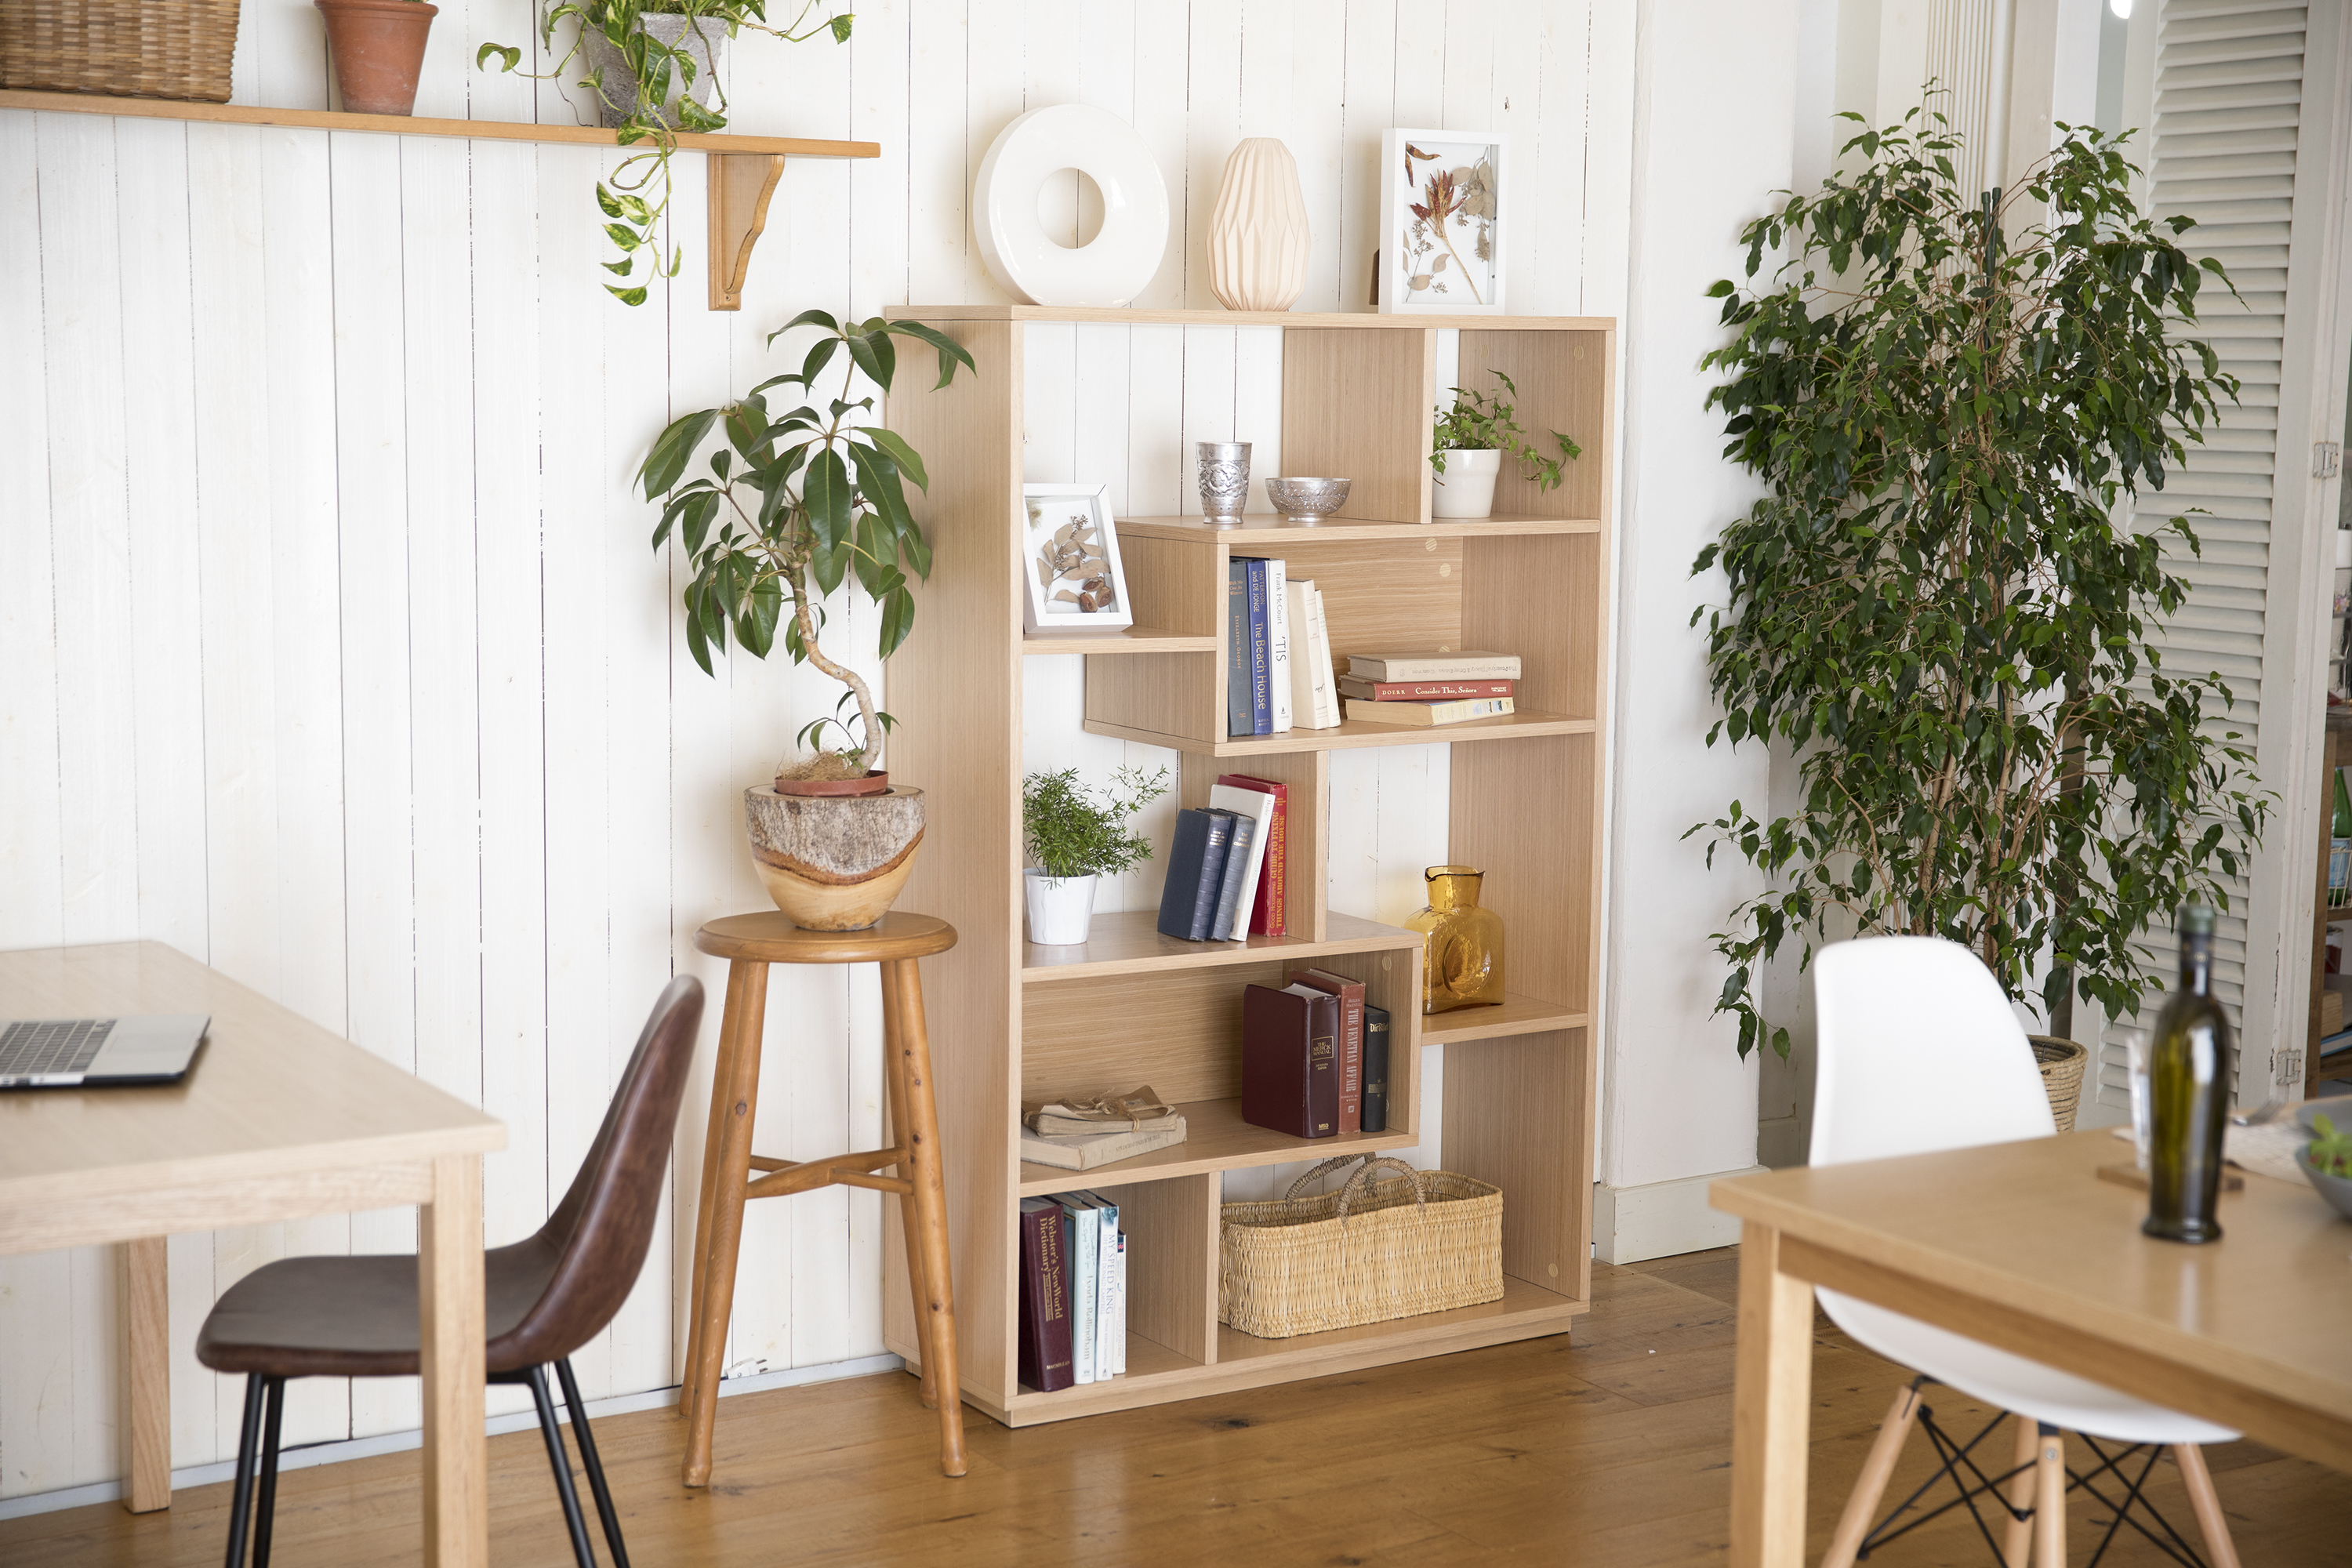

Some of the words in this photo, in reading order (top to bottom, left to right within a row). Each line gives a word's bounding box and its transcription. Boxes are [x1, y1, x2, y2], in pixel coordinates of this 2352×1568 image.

[1253, 583, 1259, 592] DE
[1255, 640, 1267, 673] Beach
[1257, 675, 1267, 710] House
[1272, 840, 1278, 852] TO
[1348, 1008, 1359, 1025] THE
[1347, 1026, 1358, 1063] VENETIAN
[1345, 1065, 1357, 1092] AFFAIR
[1040, 1217, 1051, 1272] Dictionary
[1048, 1214, 1059, 1265] Webster's
[1109, 1234, 1116, 1250] MY
[1082, 1276, 1094, 1304] Lynda
[1105, 1287, 1114, 1315] KING
[1082, 1307, 1094, 1360] Bellingham
[1047, 1360, 1070, 1370] MACMILLAN
